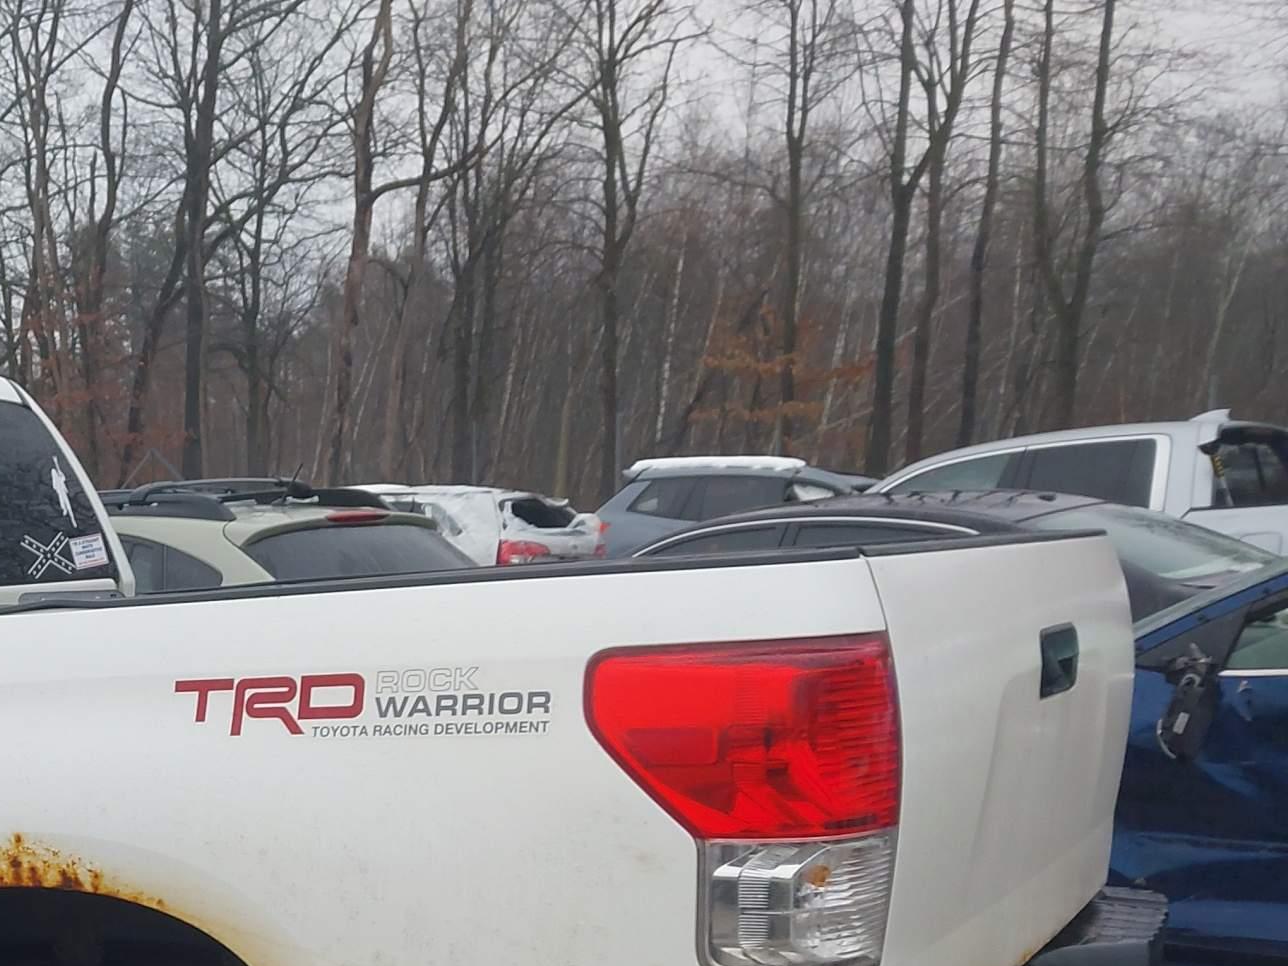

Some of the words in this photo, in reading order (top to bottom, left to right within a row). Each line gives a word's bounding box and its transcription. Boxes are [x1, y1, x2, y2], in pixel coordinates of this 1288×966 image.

[174, 671, 366, 737] TRD
[374, 666, 481, 694] ROCK
[375, 691, 552, 719] WARRIOR
[311, 724, 369, 738] TOYOTA
[372, 722, 430, 737] RACING
[433, 719, 551, 736] DEVELOPMENT
